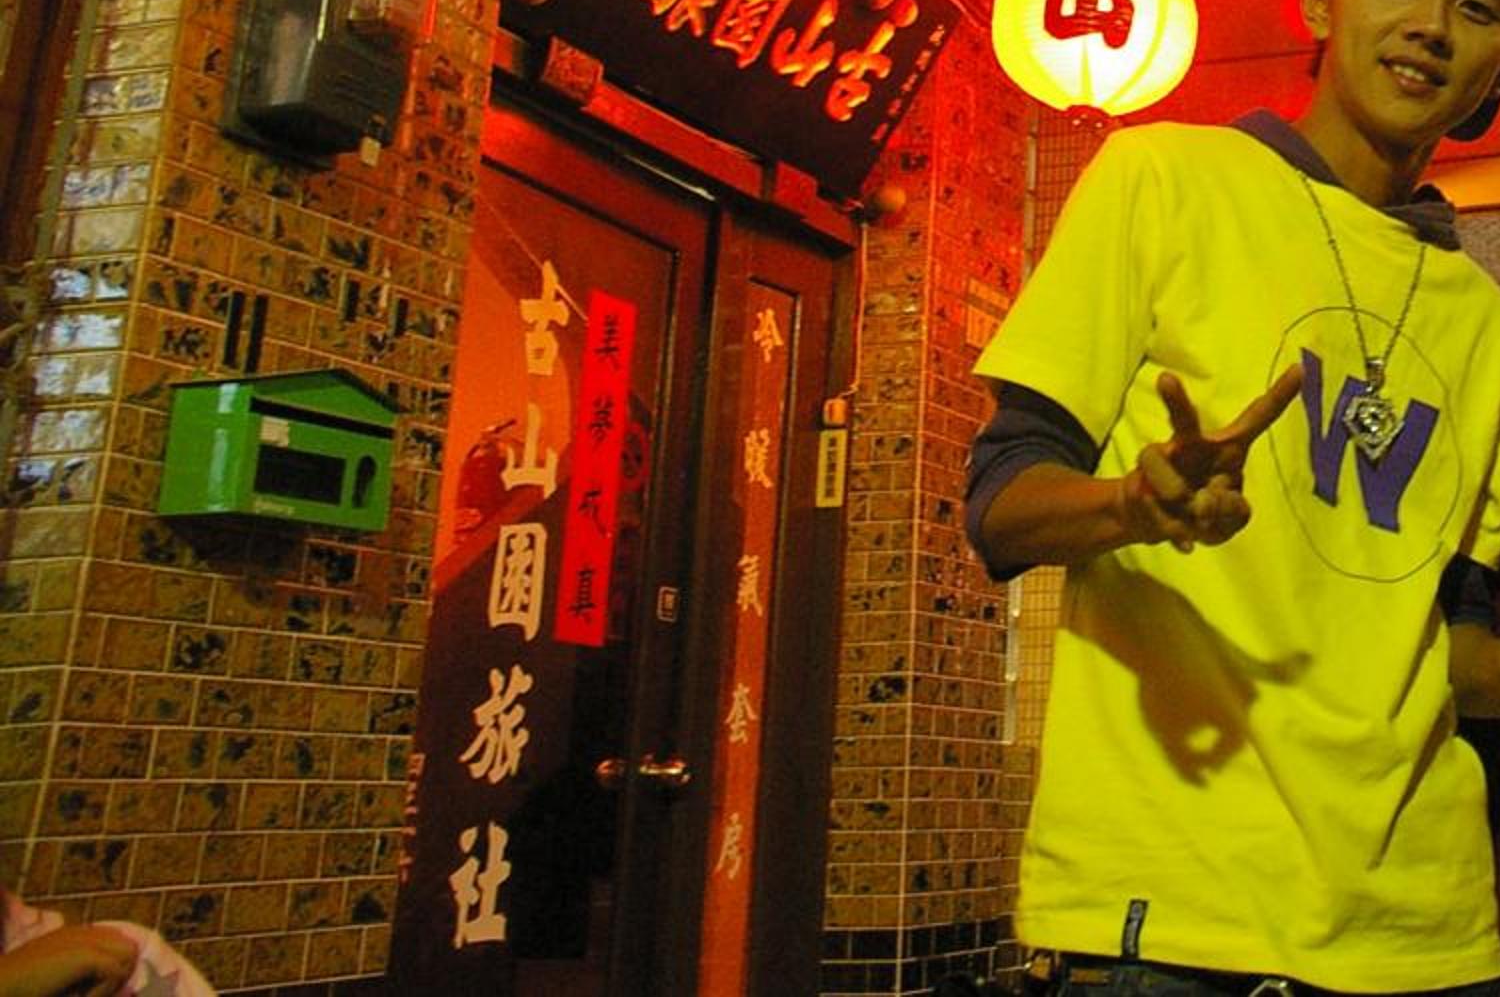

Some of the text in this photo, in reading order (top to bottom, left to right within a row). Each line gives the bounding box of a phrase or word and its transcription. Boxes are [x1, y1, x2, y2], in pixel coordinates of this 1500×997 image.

[449, 260, 569, 949] 古山園旅社
[715, 308, 784, 880] 冷暖氣套房
